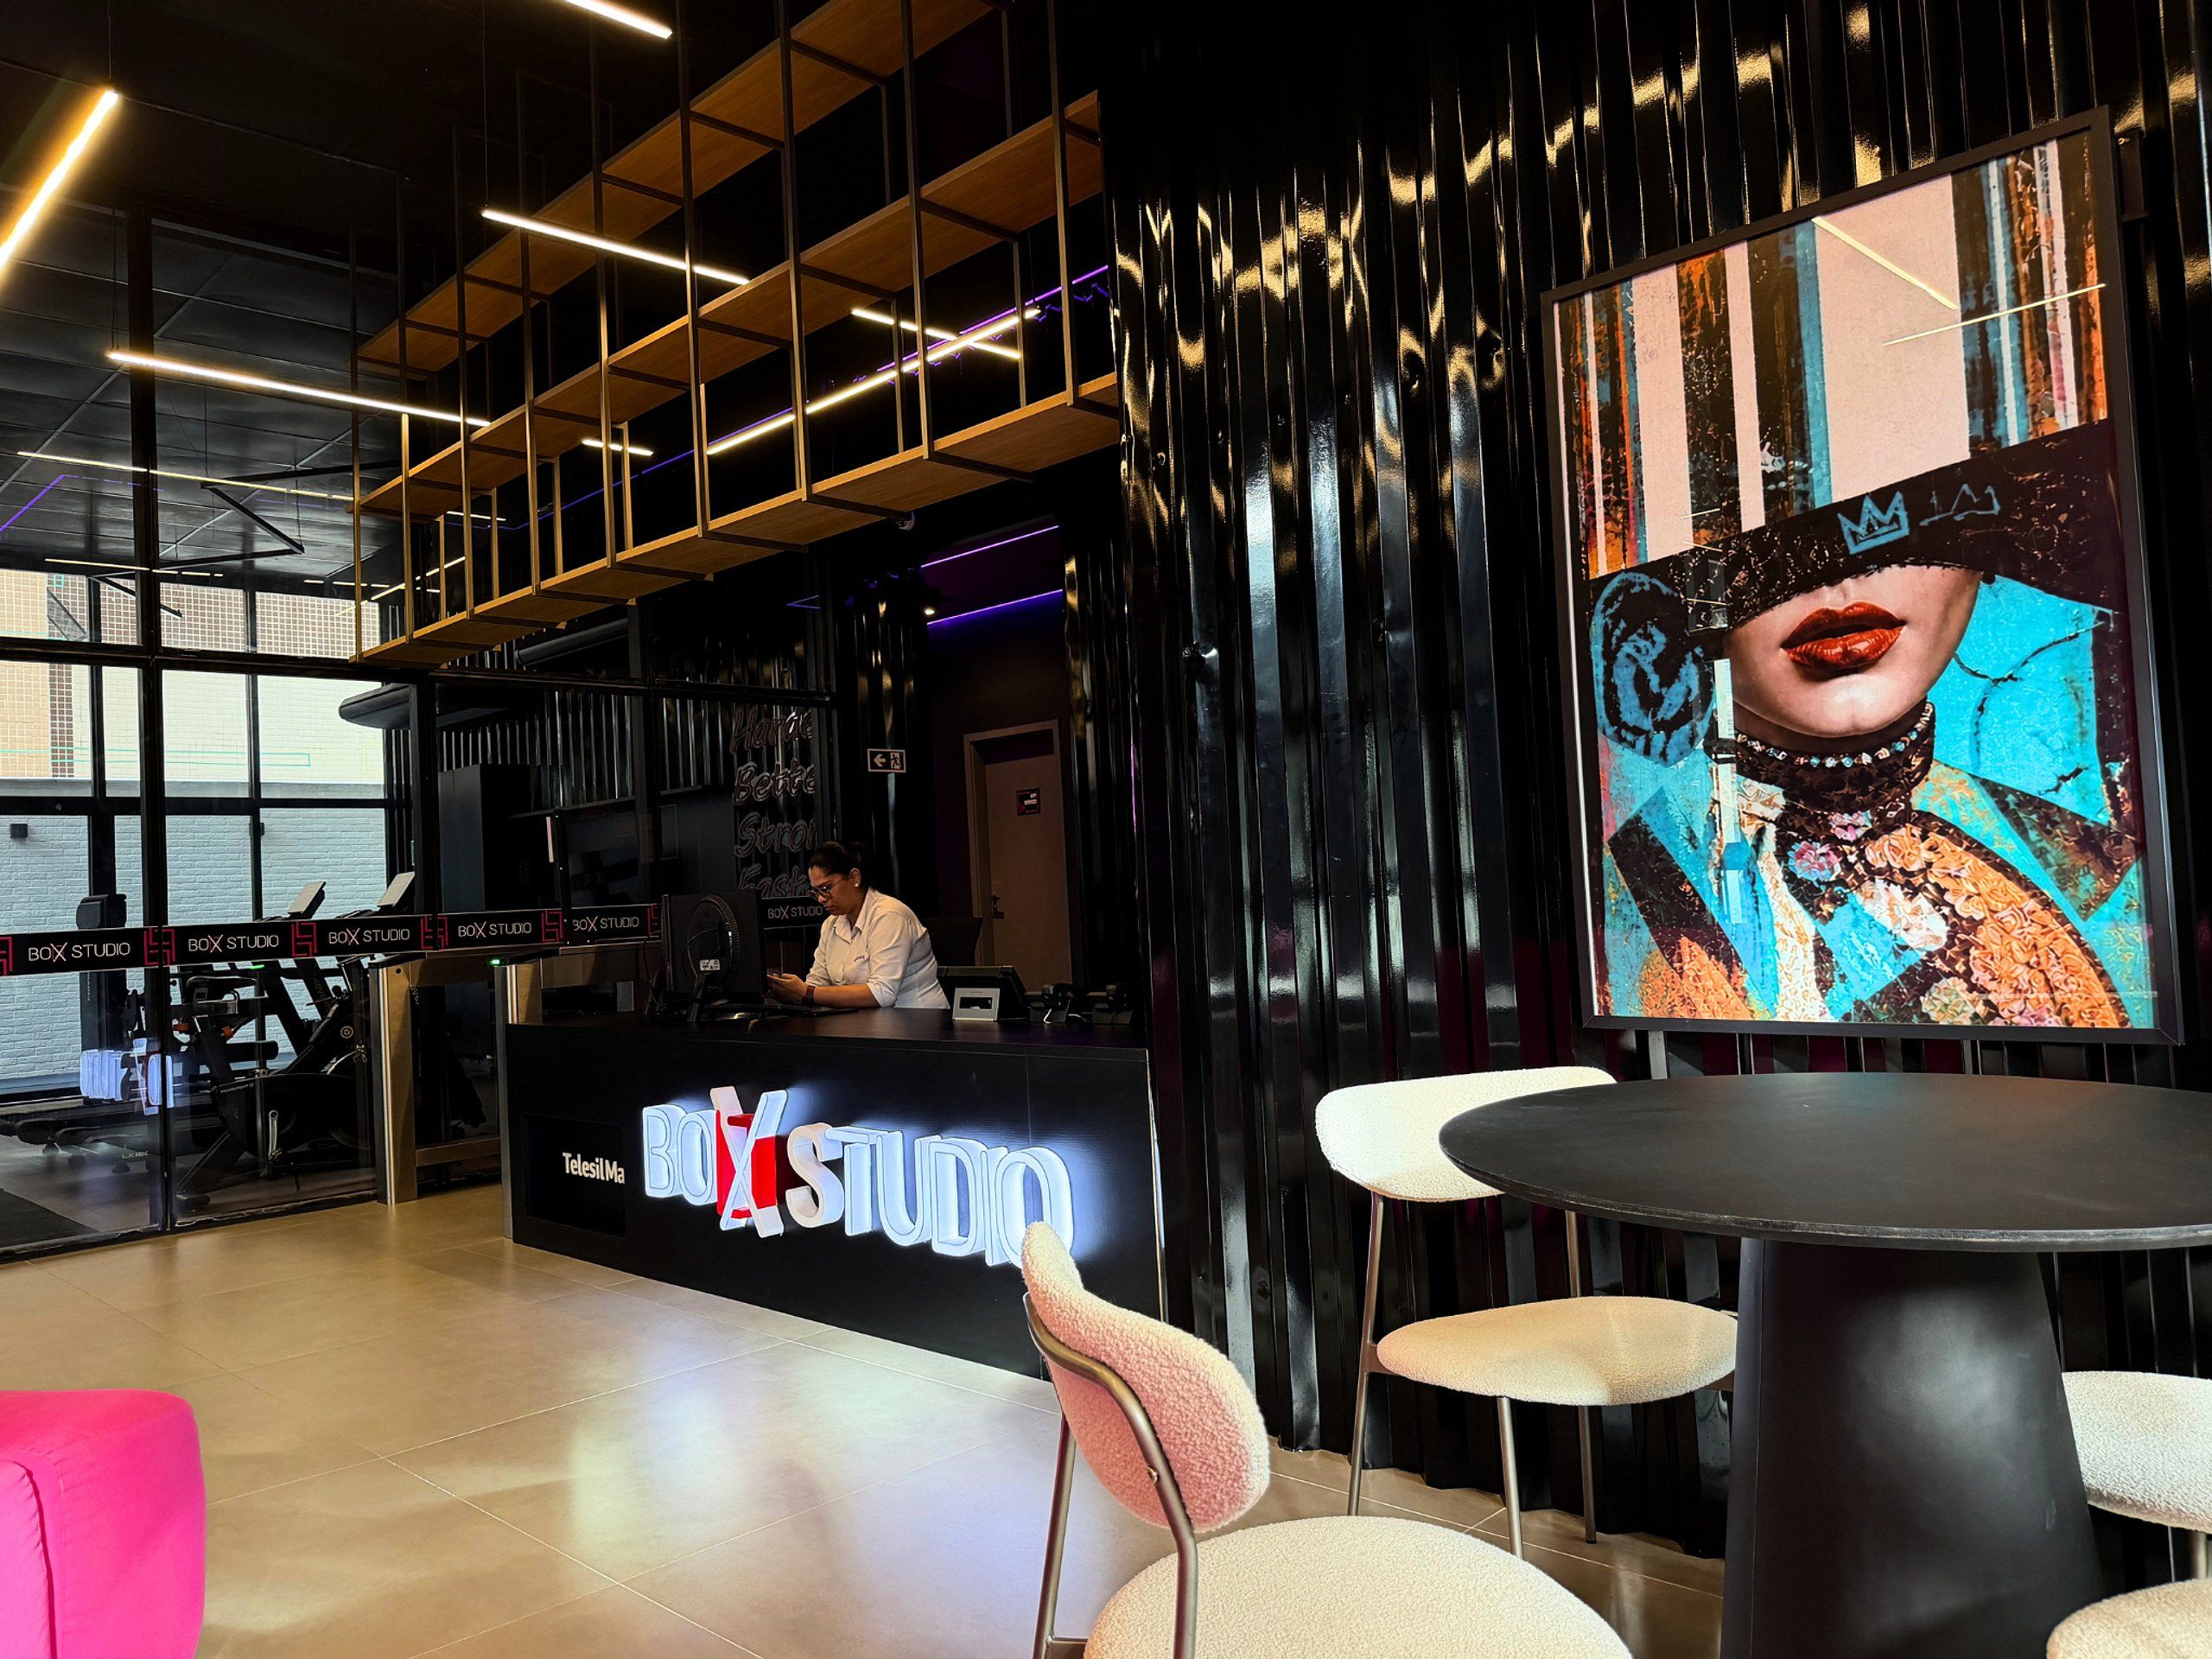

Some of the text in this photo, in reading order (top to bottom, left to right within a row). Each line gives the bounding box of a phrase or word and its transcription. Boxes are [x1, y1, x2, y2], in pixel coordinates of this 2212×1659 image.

[767, 905, 823, 919] BOX STUDIO
[458, 921, 532, 938] BOX STUDIO
[600, 916, 639, 929] STUDIO
[188, 934, 279, 952] BOX STUDIO
[328, 928, 410, 945] BOX STUDIO
[28, 942, 130, 963] BOX STUDIO
[642, 1085, 1074, 1269] BOX STUDIO
